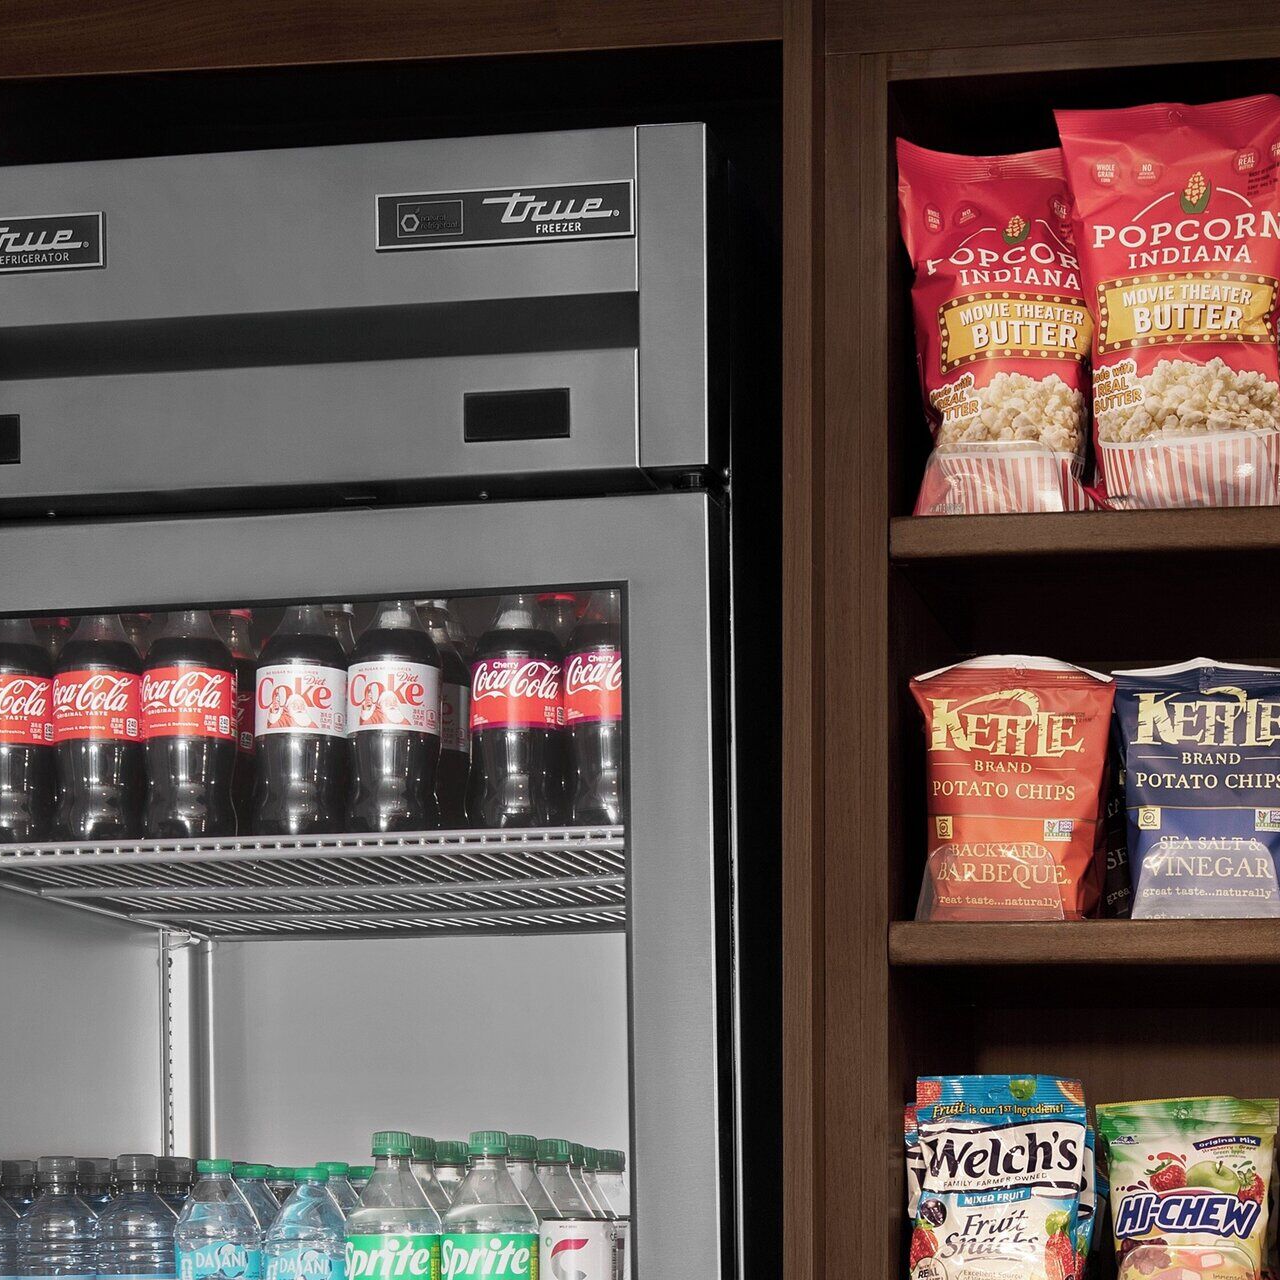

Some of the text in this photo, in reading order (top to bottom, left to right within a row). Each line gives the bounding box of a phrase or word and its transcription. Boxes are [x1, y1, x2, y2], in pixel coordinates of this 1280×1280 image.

[1142, 164, 1152, 172] NO
[1238, 155, 1255, 166] REAL
[482, 192, 612, 223] true
[536, 222, 581, 234] FREEZER
[1128, 244, 1252, 269] INDIANA
[959, 267, 1081, 290] INDIANA
[1123, 283, 1252, 307] MOVIE THEATER
[960, 302, 1084, 326] MOVIE THEATER
[1133, 304, 1244, 333] BUTTER
[970, 324, 1078, 350] BUTTER
[1097, 377, 1129, 397] REAL
[1094, 390, 1142, 414] BUTTER
[588, 654, 614, 663] Cherry
[304, 676, 326, 685] Diet
[397, 672, 418, 682] Diet
[472, 662, 561, 701] Coca-Cola
[53, 674, 133, 715] Coca-Cola
[142, 672, 226, 713] Coca-Cola
[258, 677, 332, 710] Coke
[350, 674, 424, 707] Coke
[926, 688, 1085, 757] KETTLE
[975, 760, 1032, 773] BRAND
[1182, 752, 1241, 765] BRAND
[933, 780, 1075, 800] POTATO CHIPS
[1136, 773, 1218, 789] POTATO
[950, 843, 1048, 858] BACKYARD
[1160, 836, 1261, 850] SEA SALT &
[937, 862, 1067, 889] BARBEQUE
[1150, 856, 1273, 878] VINEGAR
[1143, 886, 1172, 898] great
[933, 1102, 1063, 1119] Fruit is our Ingredient!
[1198, 1138, 1236, 1147] Original
[926, 1131, 1078, 1178] Welch's
[944, 1173, 1047, 1189] FAMILY FARMER OWNED
[964, 1191, 1025, 1205] MIXED FRUIT
[961, 1210, 1029, 1236] Fruit
[1116, 1195, 1261, 1239] HI-CHEW
[195, 1247, 246, 1269] DASANI
[280, 1254, 330, 1274] DASANI
[918, 1267, 939, 1278] REAL
